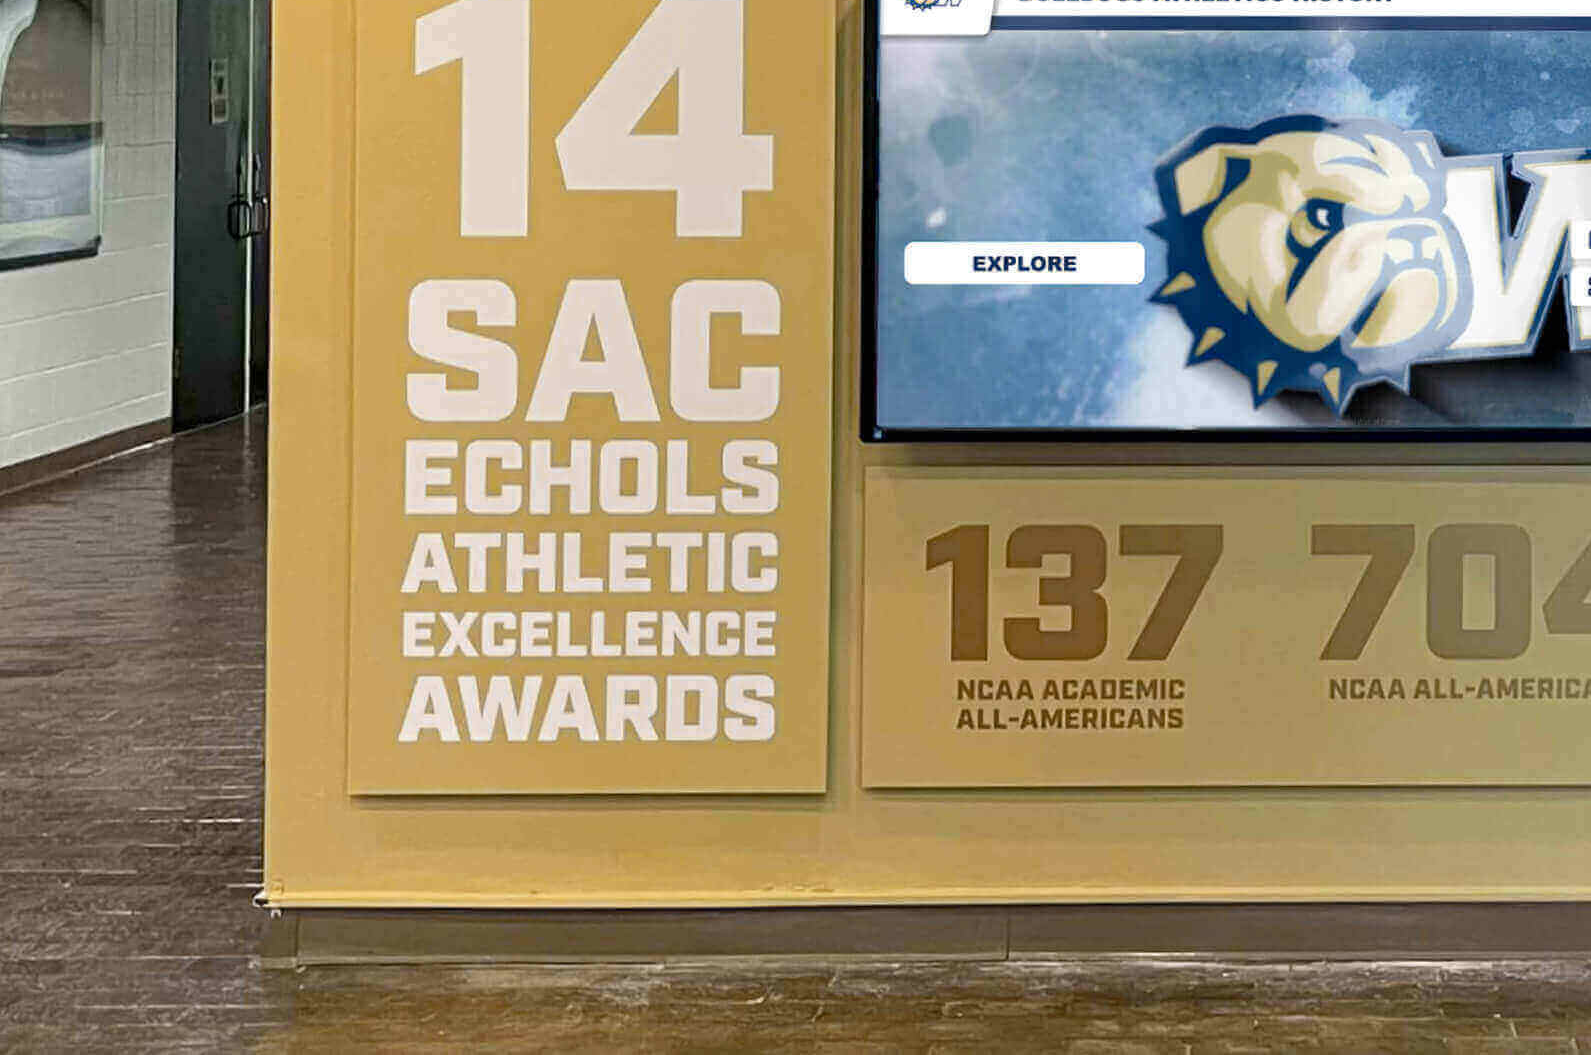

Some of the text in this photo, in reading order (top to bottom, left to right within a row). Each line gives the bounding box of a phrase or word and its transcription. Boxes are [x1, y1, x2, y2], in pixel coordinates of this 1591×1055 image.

[972, 253, 1077, 274] EXPLORE
[406, 279, 781, 422] SAC
[405, 439, 780, 516] ECHOLS
[401, 531, 778, 593] ATHLETIC
[926, 524, 1224, 662] 137
[403, 610, 776, 657] EXCELLENCE
[399, 676, 776, 743] AWARDS
[957, 678, 1185, 701] NCAA ACADEMIC
[1328, 678, 1407, 701] NCAA
[957, 707, 1185, 730] ALL-AMERICANS
